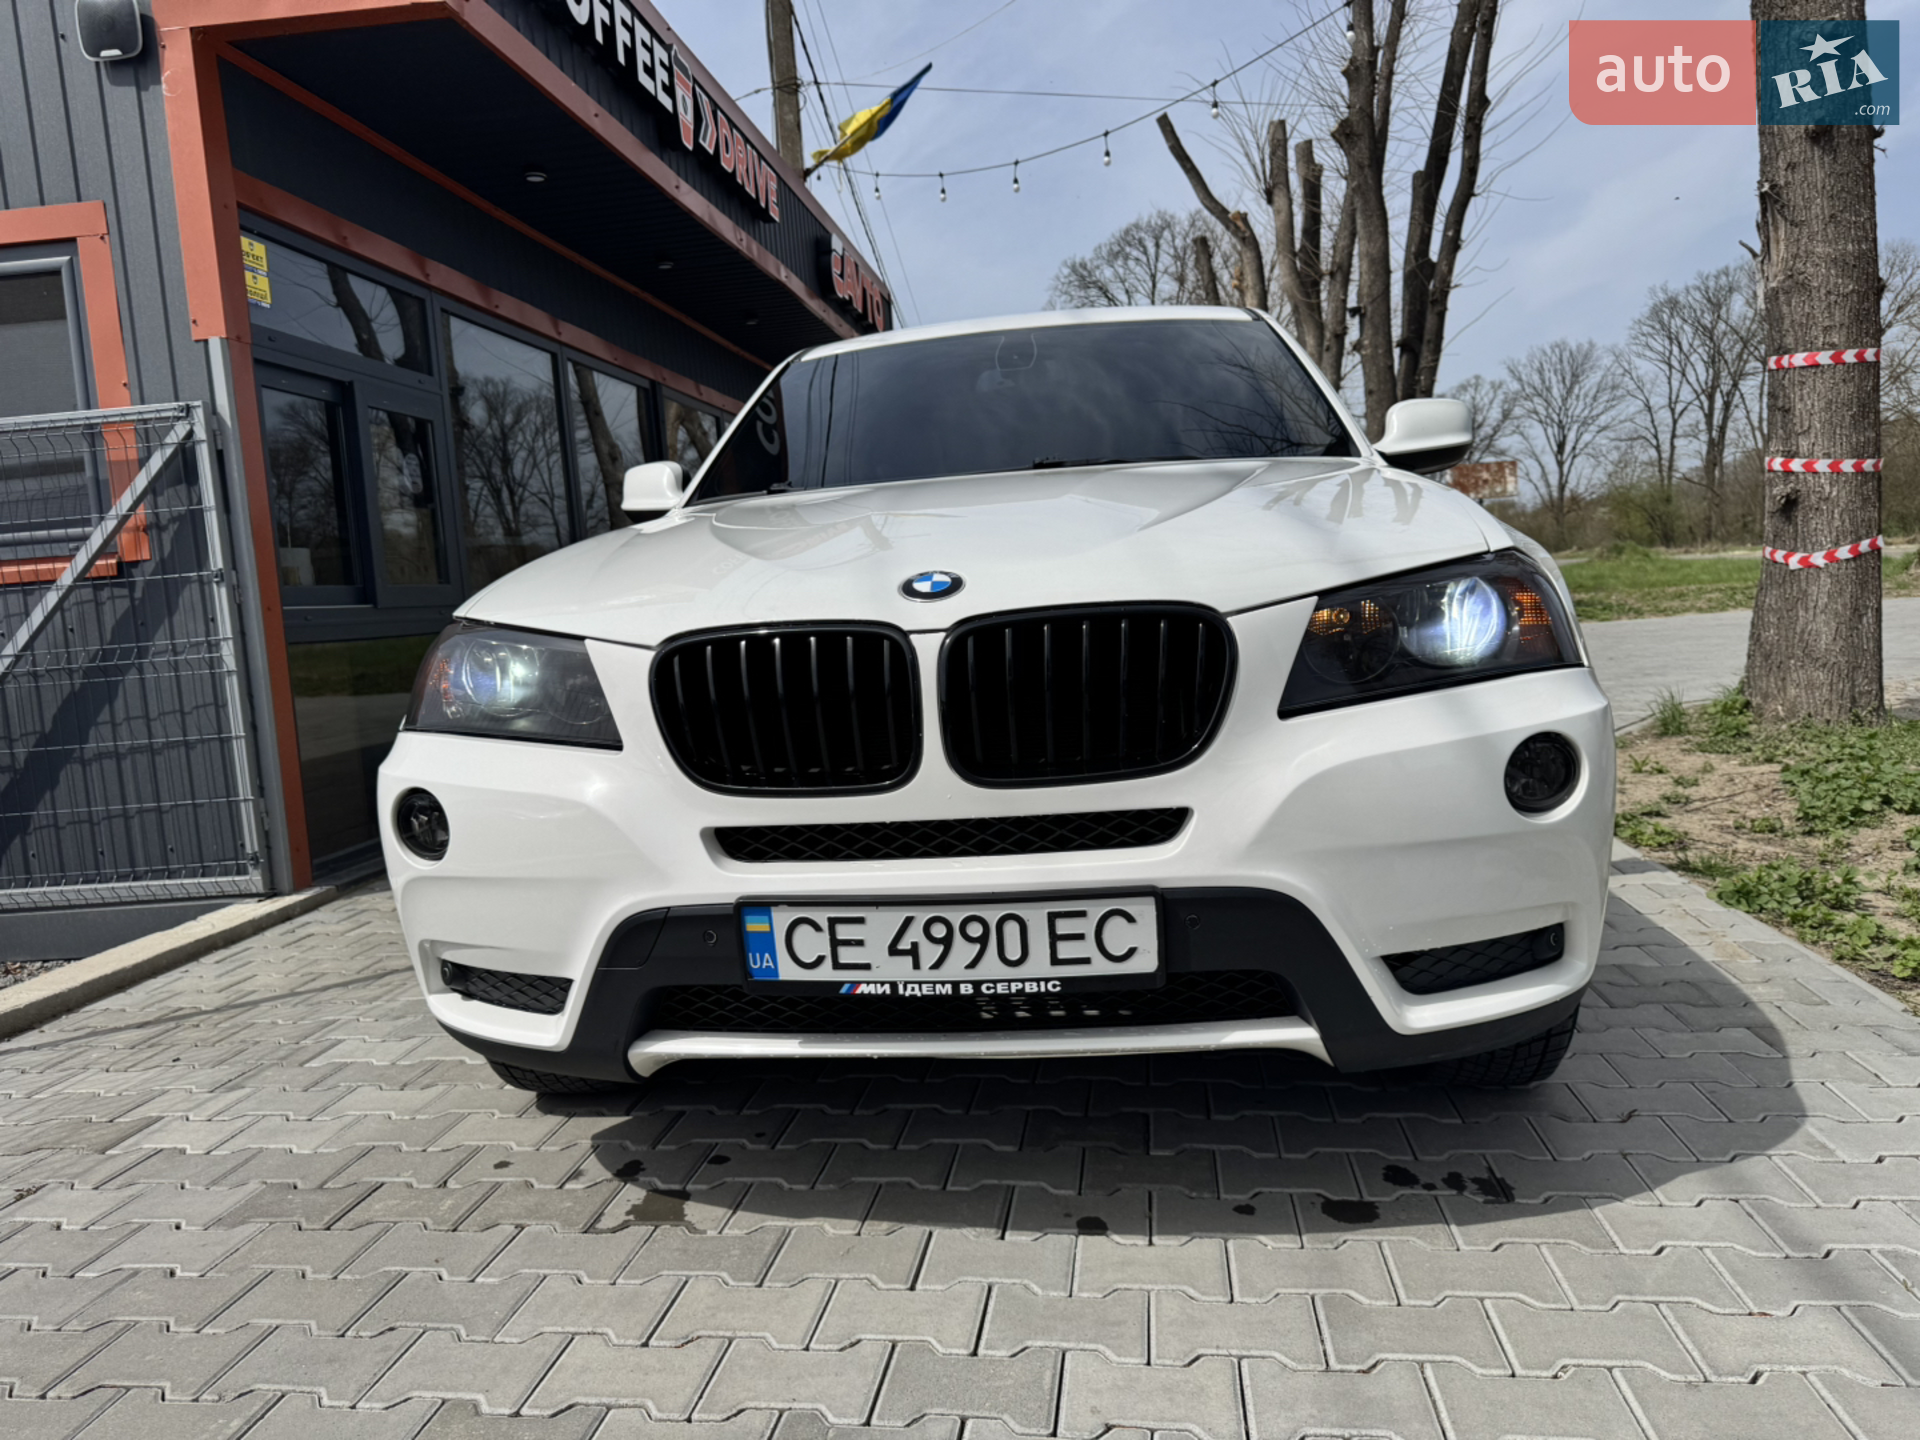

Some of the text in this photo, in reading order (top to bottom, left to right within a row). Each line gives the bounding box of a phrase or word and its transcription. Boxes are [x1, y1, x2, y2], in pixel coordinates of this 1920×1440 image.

[717, 109, 780, 223] DRIVE
[784, 907, 1138, 971] CE 4990 EC
[748, 952, 776, 969] UA
[855, 980, 1062, 997] МИ ЇДЕМ В СЕРВІС
